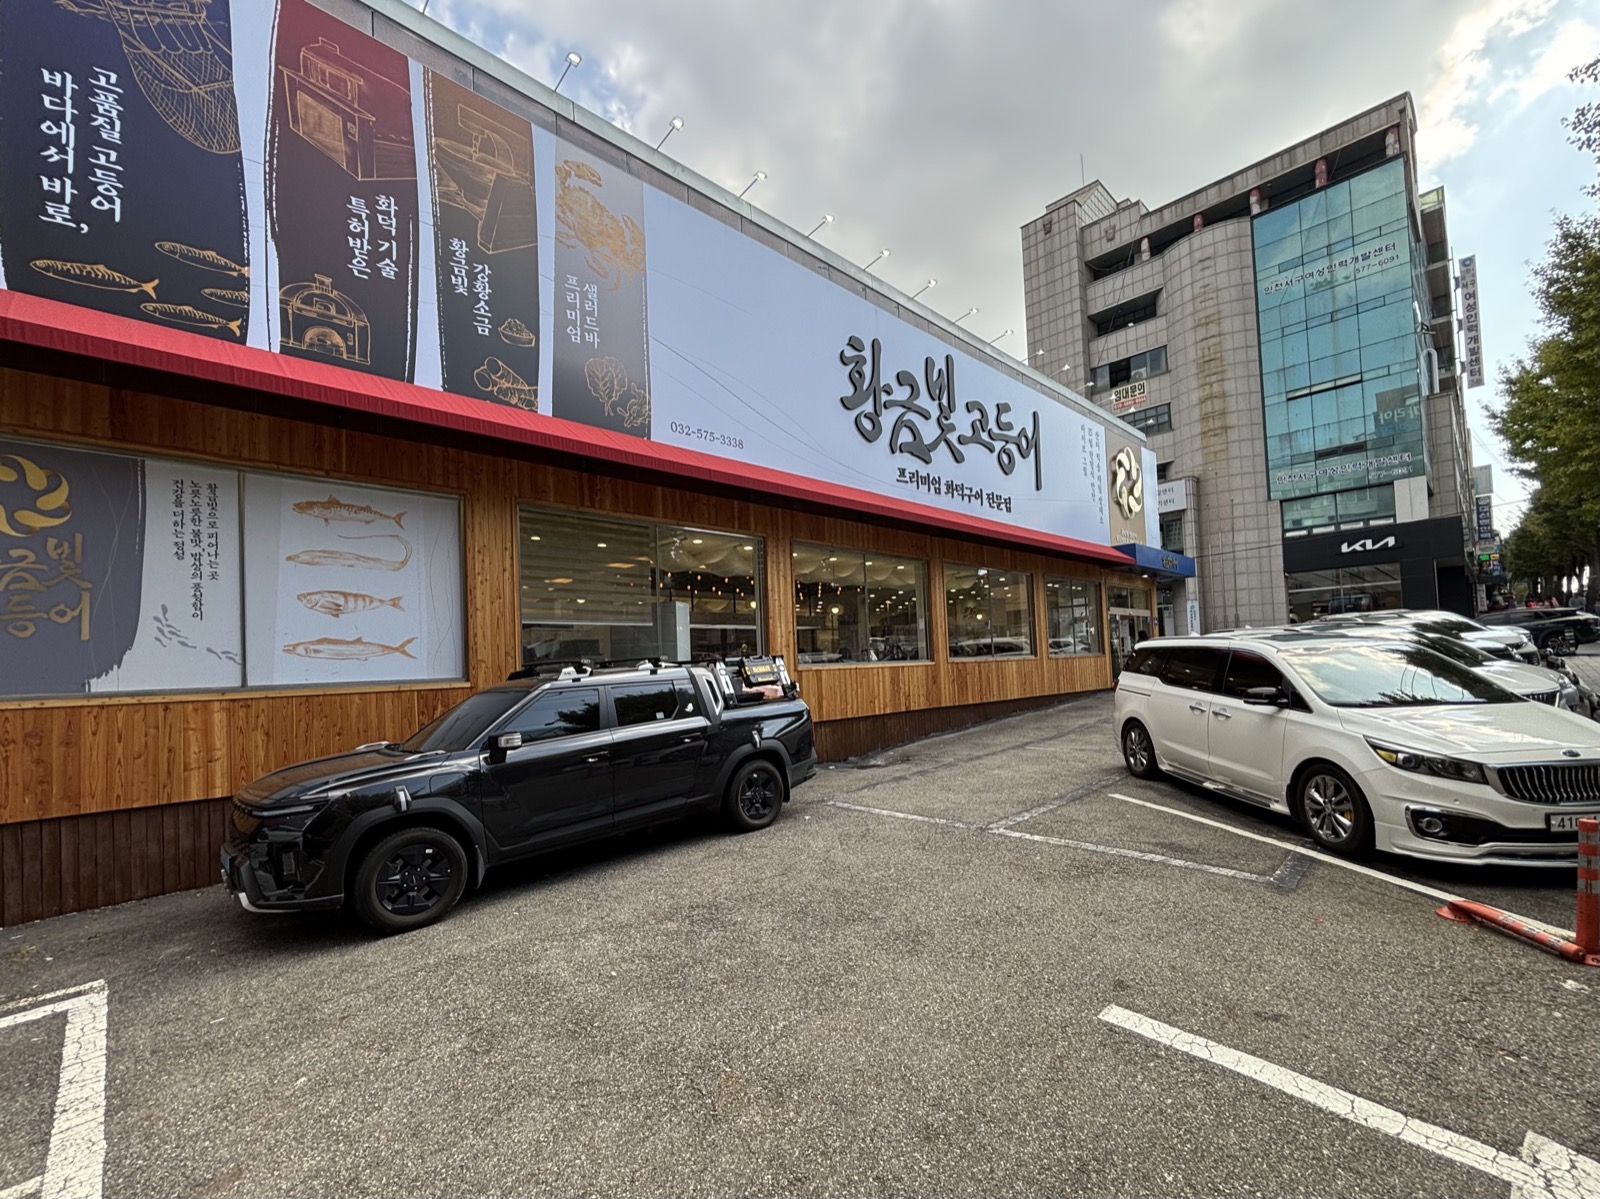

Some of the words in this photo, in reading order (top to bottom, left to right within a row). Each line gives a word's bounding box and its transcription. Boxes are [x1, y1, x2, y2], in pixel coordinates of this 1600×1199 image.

[40, 68, 79, 174] 바다에서
[88, 66, 124, 145] 고품질
[38, 175, 89, 234] 바로,
[88, 145, 124, 223] 고등어
[375, 194, 398, 236] 화덕
[346, 196, 372, 279] 특허받은
[376, 240, 398, 280] 기술
[449, 238, 469, 296] 황금빛
[1263, 242, 1396, 296] 인천서구여성인력개발센터
[1355, 254, 1400, 275] 577-6091
[473, 263, 492, 336] 강황소금
[564, 274, 581, 344] 프리미엄
[582, 283, 600, 349] 샐러드바
[1114, 382, 1145, 402] 임대문의
[670, 421, 744, 450] 032-575-3338
[172, 479, 185, 508] 건강을
[189, 480, 202, 527] 노릇노릇한
[206, 483, 218, 529] 황금빛으로
[896, 467, 941, 495] 프리미엄
[944, 480, 983, 507] 화덕구이
[985, 491, 1012, 513] 전문점
[172, 510, 185, 539] 더하는
[1341, 536, 1395, 553] KIA
[173, 540, 185, 560] 정성
[190, 552, 203, 580] 밥상의
[207, 531, 219, 569] 피어나는
[207, 571, 219, 581] 곳
[191, 583, 204, 621] 풍성함이
